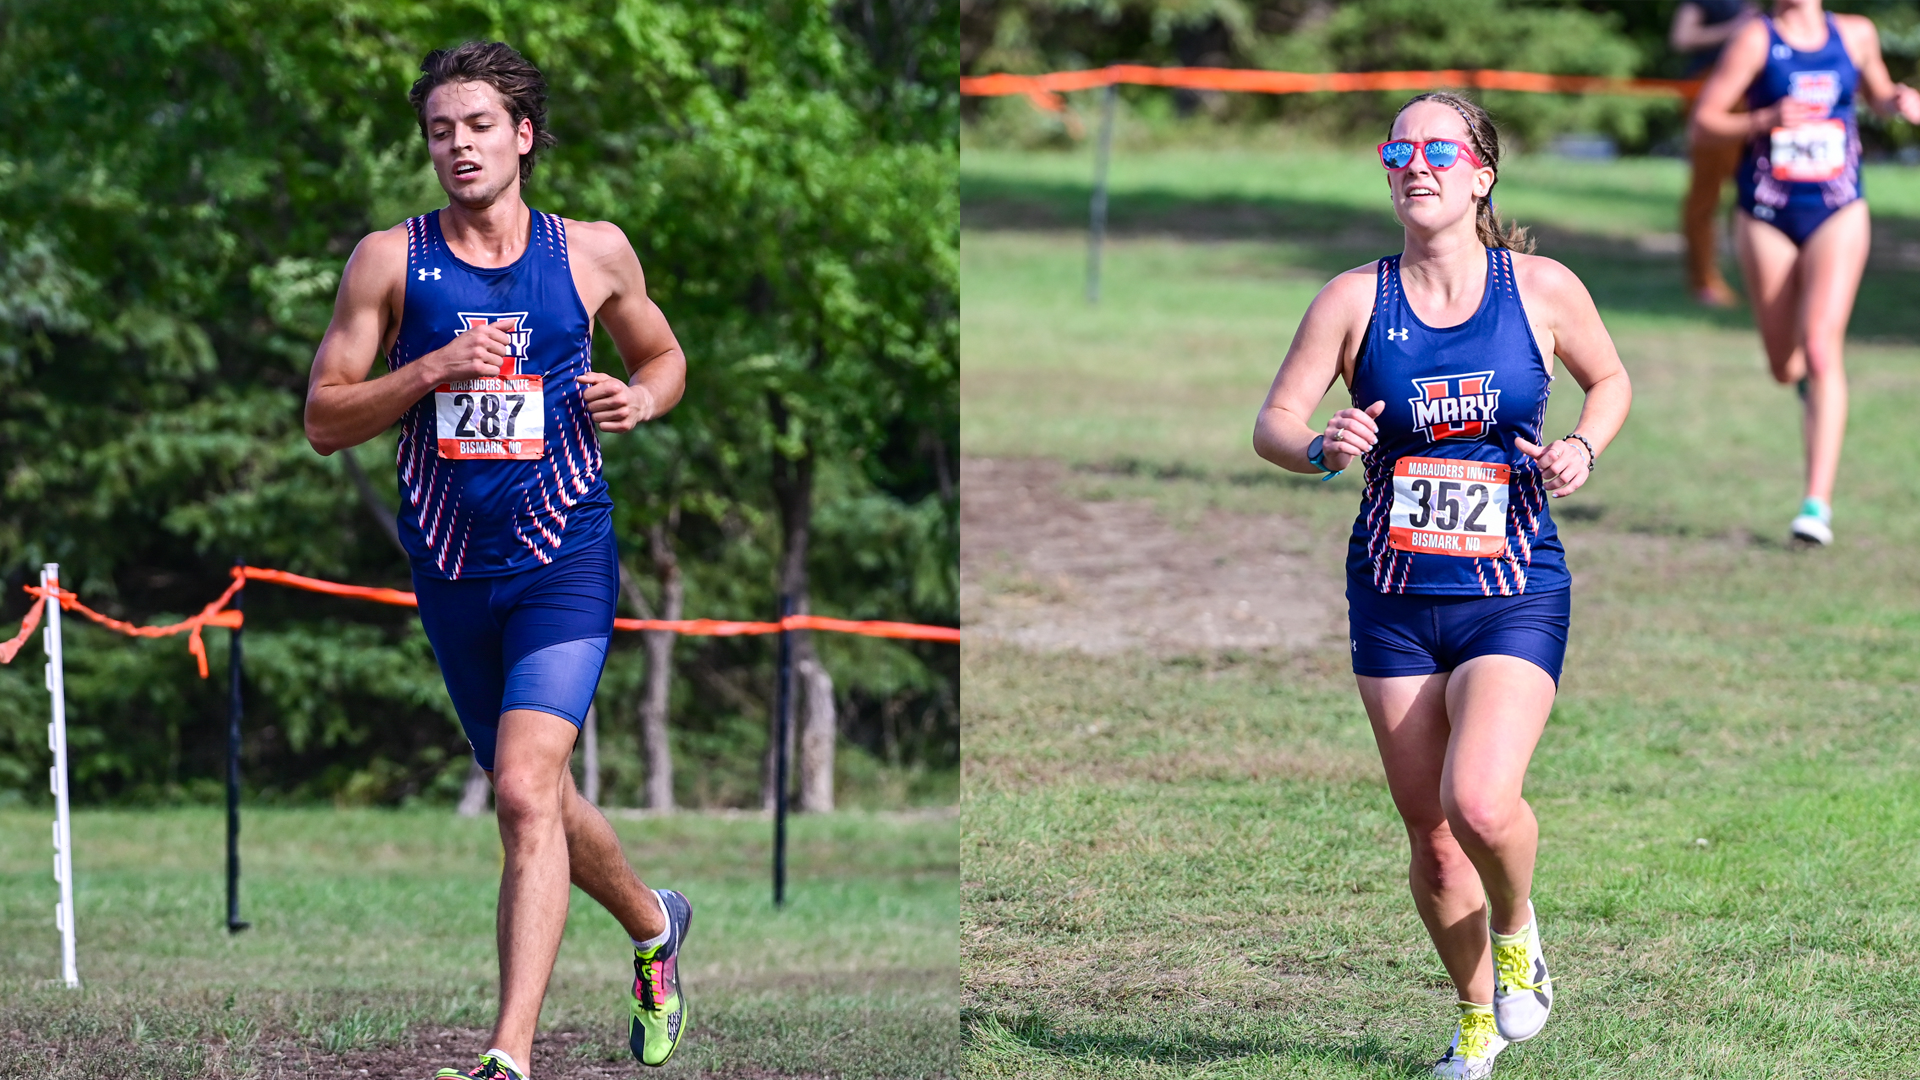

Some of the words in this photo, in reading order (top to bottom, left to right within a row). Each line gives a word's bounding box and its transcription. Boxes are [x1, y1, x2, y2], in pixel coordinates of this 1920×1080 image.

[450, 379, 501, 391] MARAUDERS
[504, 379, 530, 391] INVITE
[454, 394, 525, 438] 287
[1415, 394, 1495, 428] MARY
[460, 441, 506, 455] BISMARK,
[508, 441, 522, 454] ND
[1408, 462, 1464, 479] MARAUDERS
[1466, 466, 1497, 481] INVITE
[1409, 479, 1489, 533] 352
[1411, 531, 1462, 552] BISMARK,
[1465, 537, 1481, 552] ND
